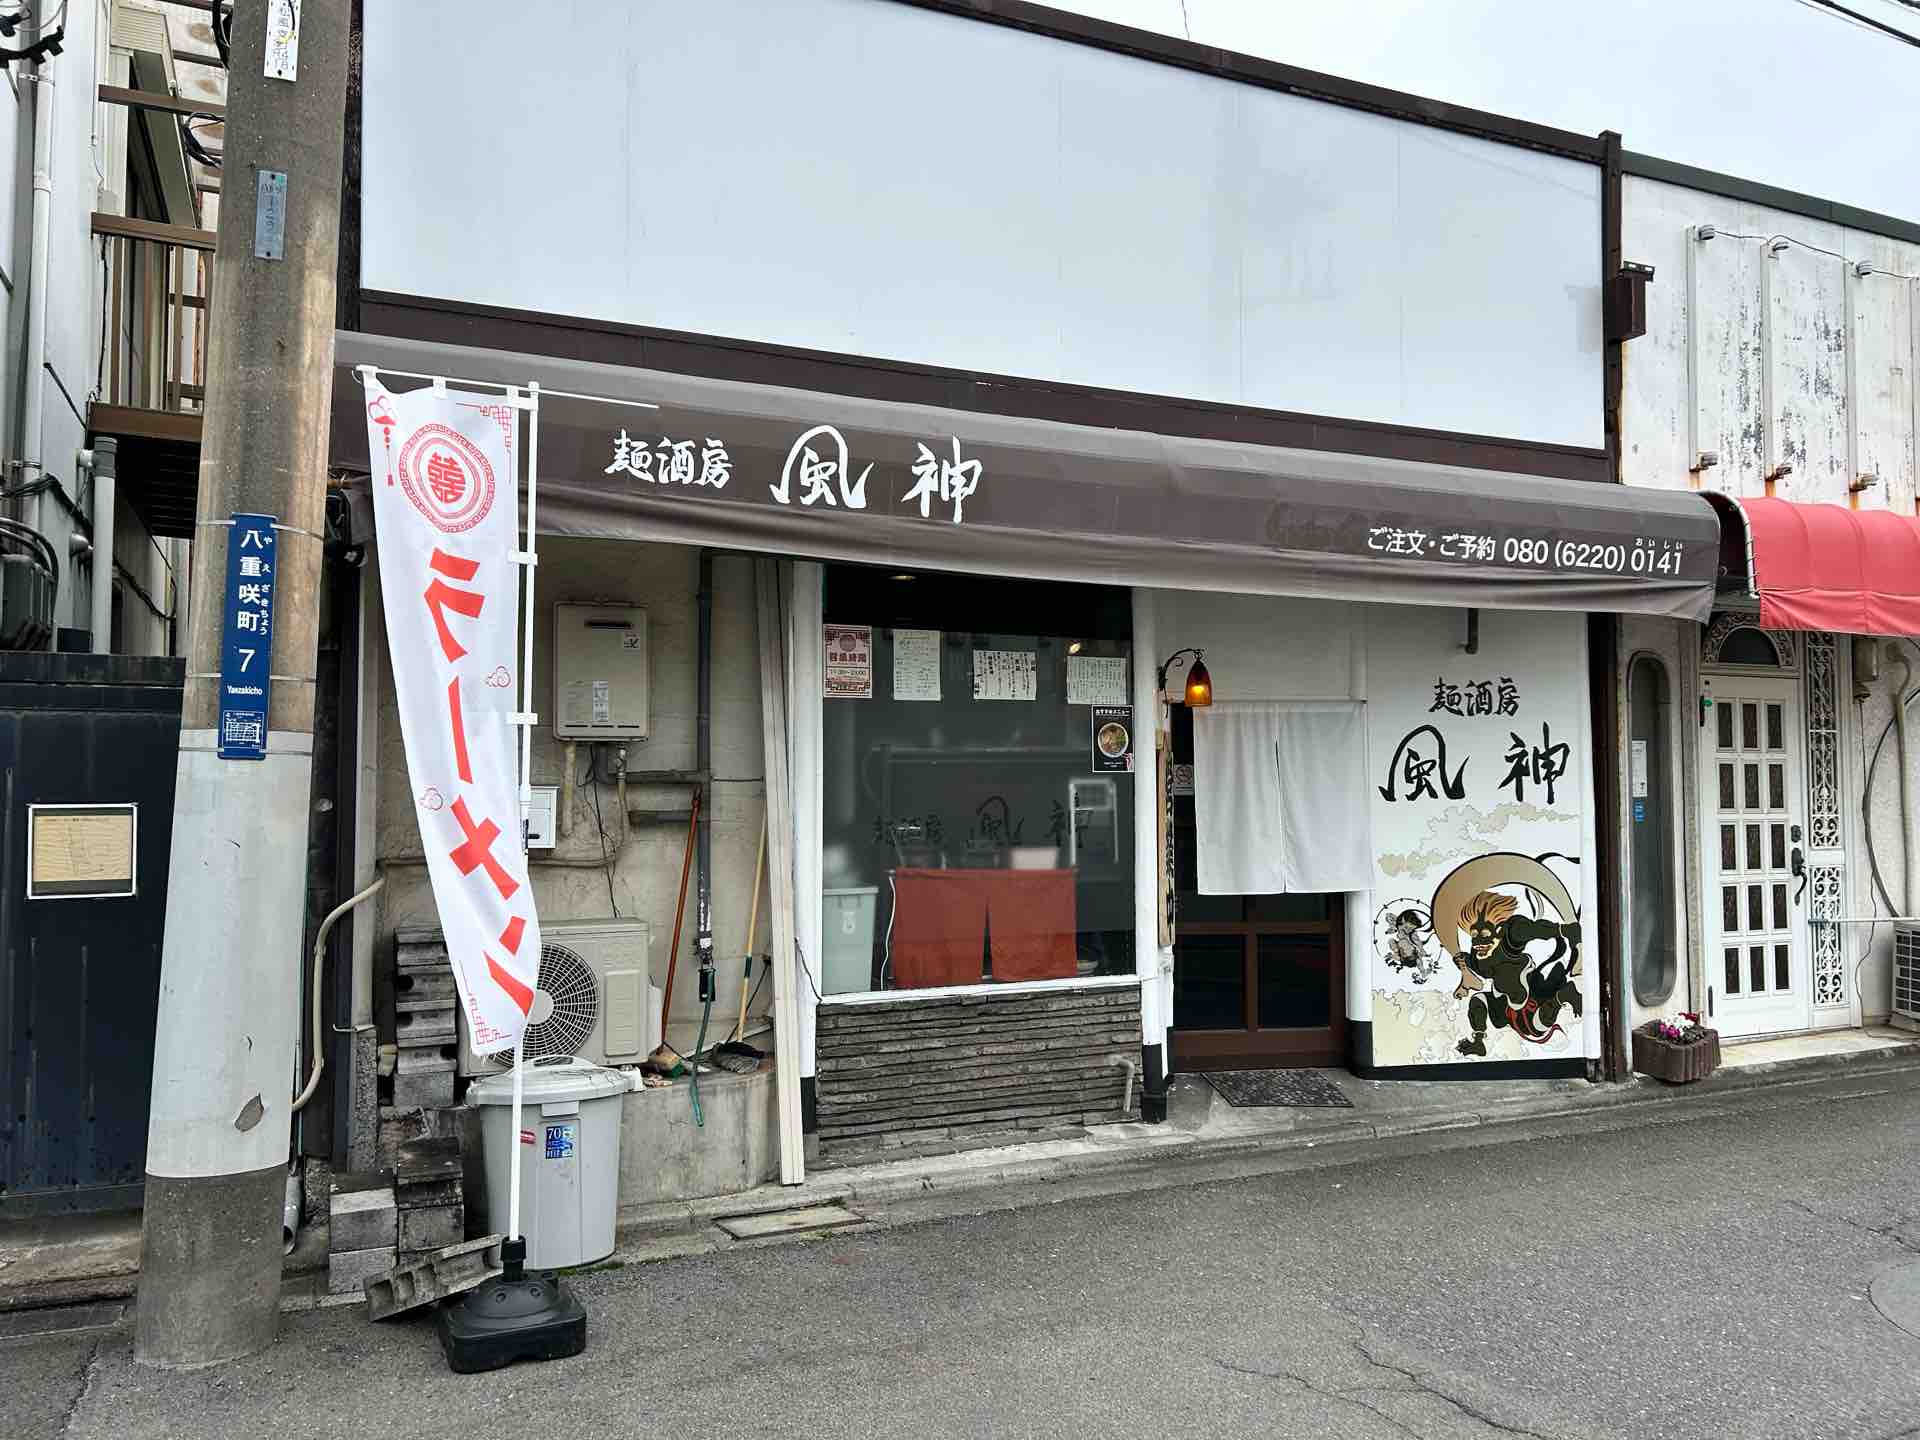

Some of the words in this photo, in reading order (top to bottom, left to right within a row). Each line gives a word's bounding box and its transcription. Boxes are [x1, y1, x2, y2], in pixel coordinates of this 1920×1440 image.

[605, 429, 734, 488] 麺酒房
[1367, 527, 1496, 561] ご注文・ご予約
[1635, 537, 1683, 550] おいしい
[237, 529, 264, 632] 八重咲町
[260, 536, 273, 636] やえざきちょう
[238, 648, 256, 673] 7
[1428, 676, 1521, 717] 麺酒房
[423, 547, 534, 1018] ラーメン
